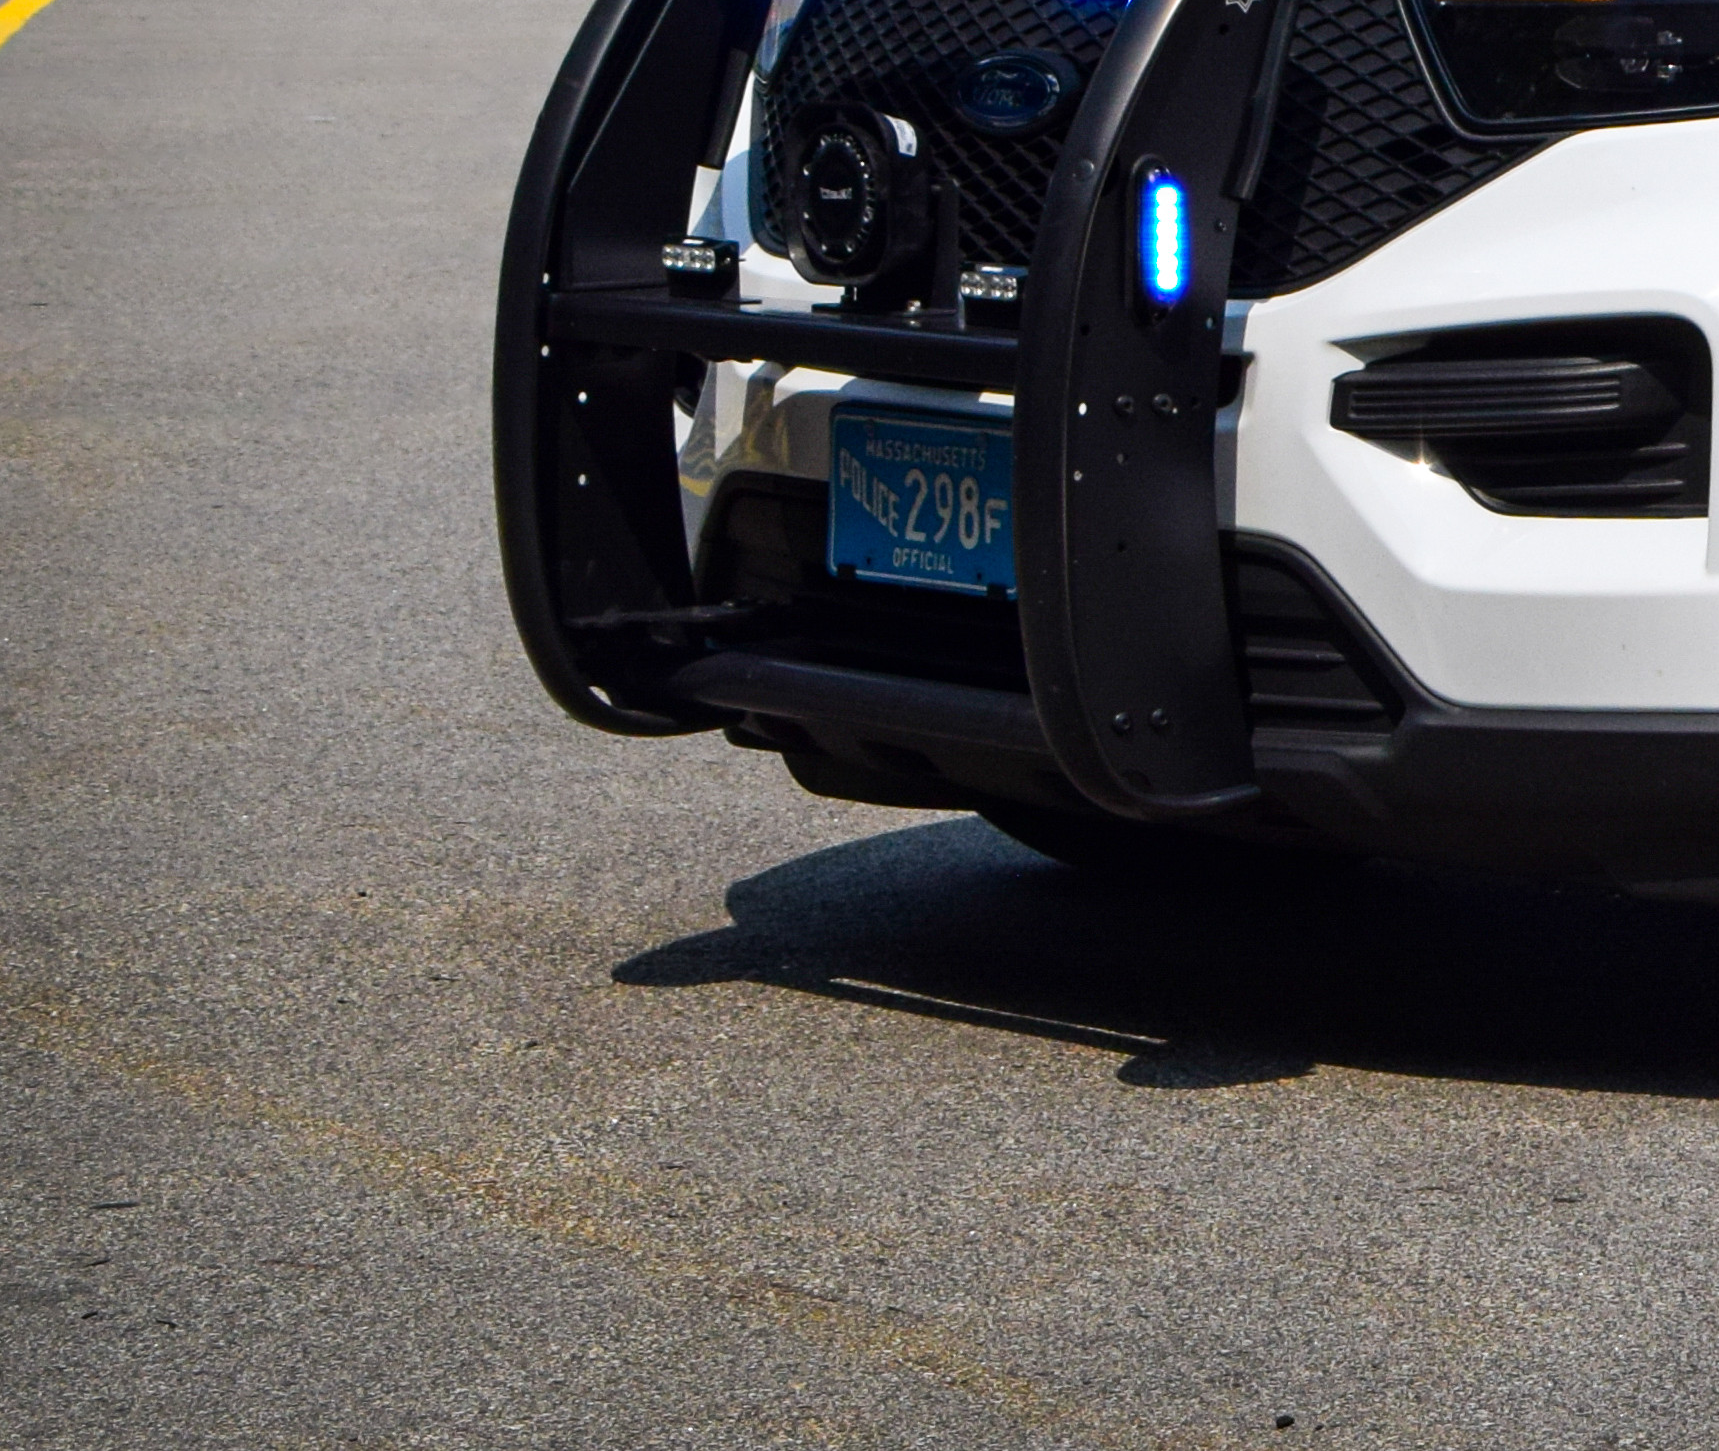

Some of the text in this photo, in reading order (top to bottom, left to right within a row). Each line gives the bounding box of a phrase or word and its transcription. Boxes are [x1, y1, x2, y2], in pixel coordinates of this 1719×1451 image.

[865, 438, 987, 472] MASSACHUSETTS
[839, 447, 900, 538] POLICE
[892, 546, 955, 575] OFFICIAL
